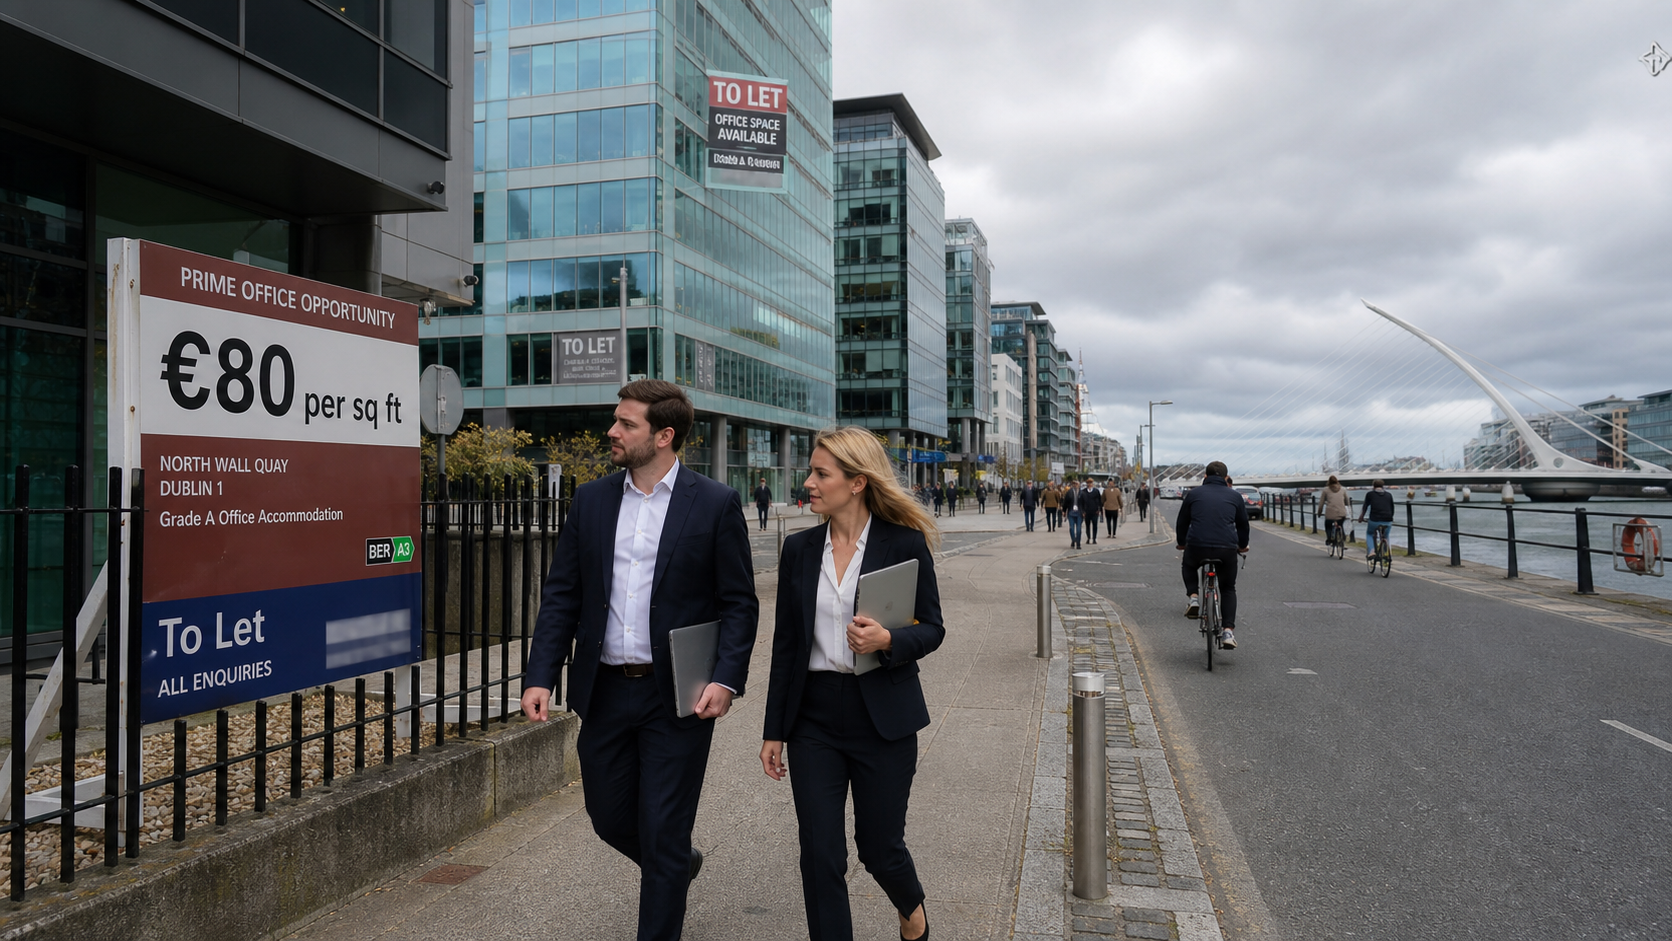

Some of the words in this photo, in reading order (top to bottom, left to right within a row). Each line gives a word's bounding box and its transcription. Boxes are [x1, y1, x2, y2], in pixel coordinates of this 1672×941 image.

[713, 81, 741, 105] TO
[747, 84, 783, 109] LET
[715, 113, 748, 128] OFFICE
[750, 117, 780, 131] SPACE
[717, 127, 777, 145] AVAILABLE
[180, 266, 237, 297] PRIME
[241, 282, 297, 310] OFFICE
[300, 293, 396, 329] OPPORTUNITY
[562, 338, 584, 356] TO
[588, 336, 616, 354] LET
[159, 330, 295, 417] €80
[304, 392, 346, 425] per
[353, 397, 378, 430] sq
[385, 392, 402, 424] ft
[159, 455, 211, 473] NORTH
[214, 456, 251, 474] WALL
[254, 457, 289, 474] QUAY
[159, 480, 213, 497] DUBLIN
[216, 480, 223, 496] 1
[159, 510, 202, 528] Grade
[204, 510, 216, 526] A
[219, 509, 255, 525] Office
[258, 507, 343, 524] Accommodation
[369, 543, 391, 559] BER
[397, 542, 411, 557] A3
[158, 617, 203, 658] To
[215, 609, 266, 650] Let
[157, 676, 189, 699] ALL
[193, 659, 272, 692] ENQUIRIES
